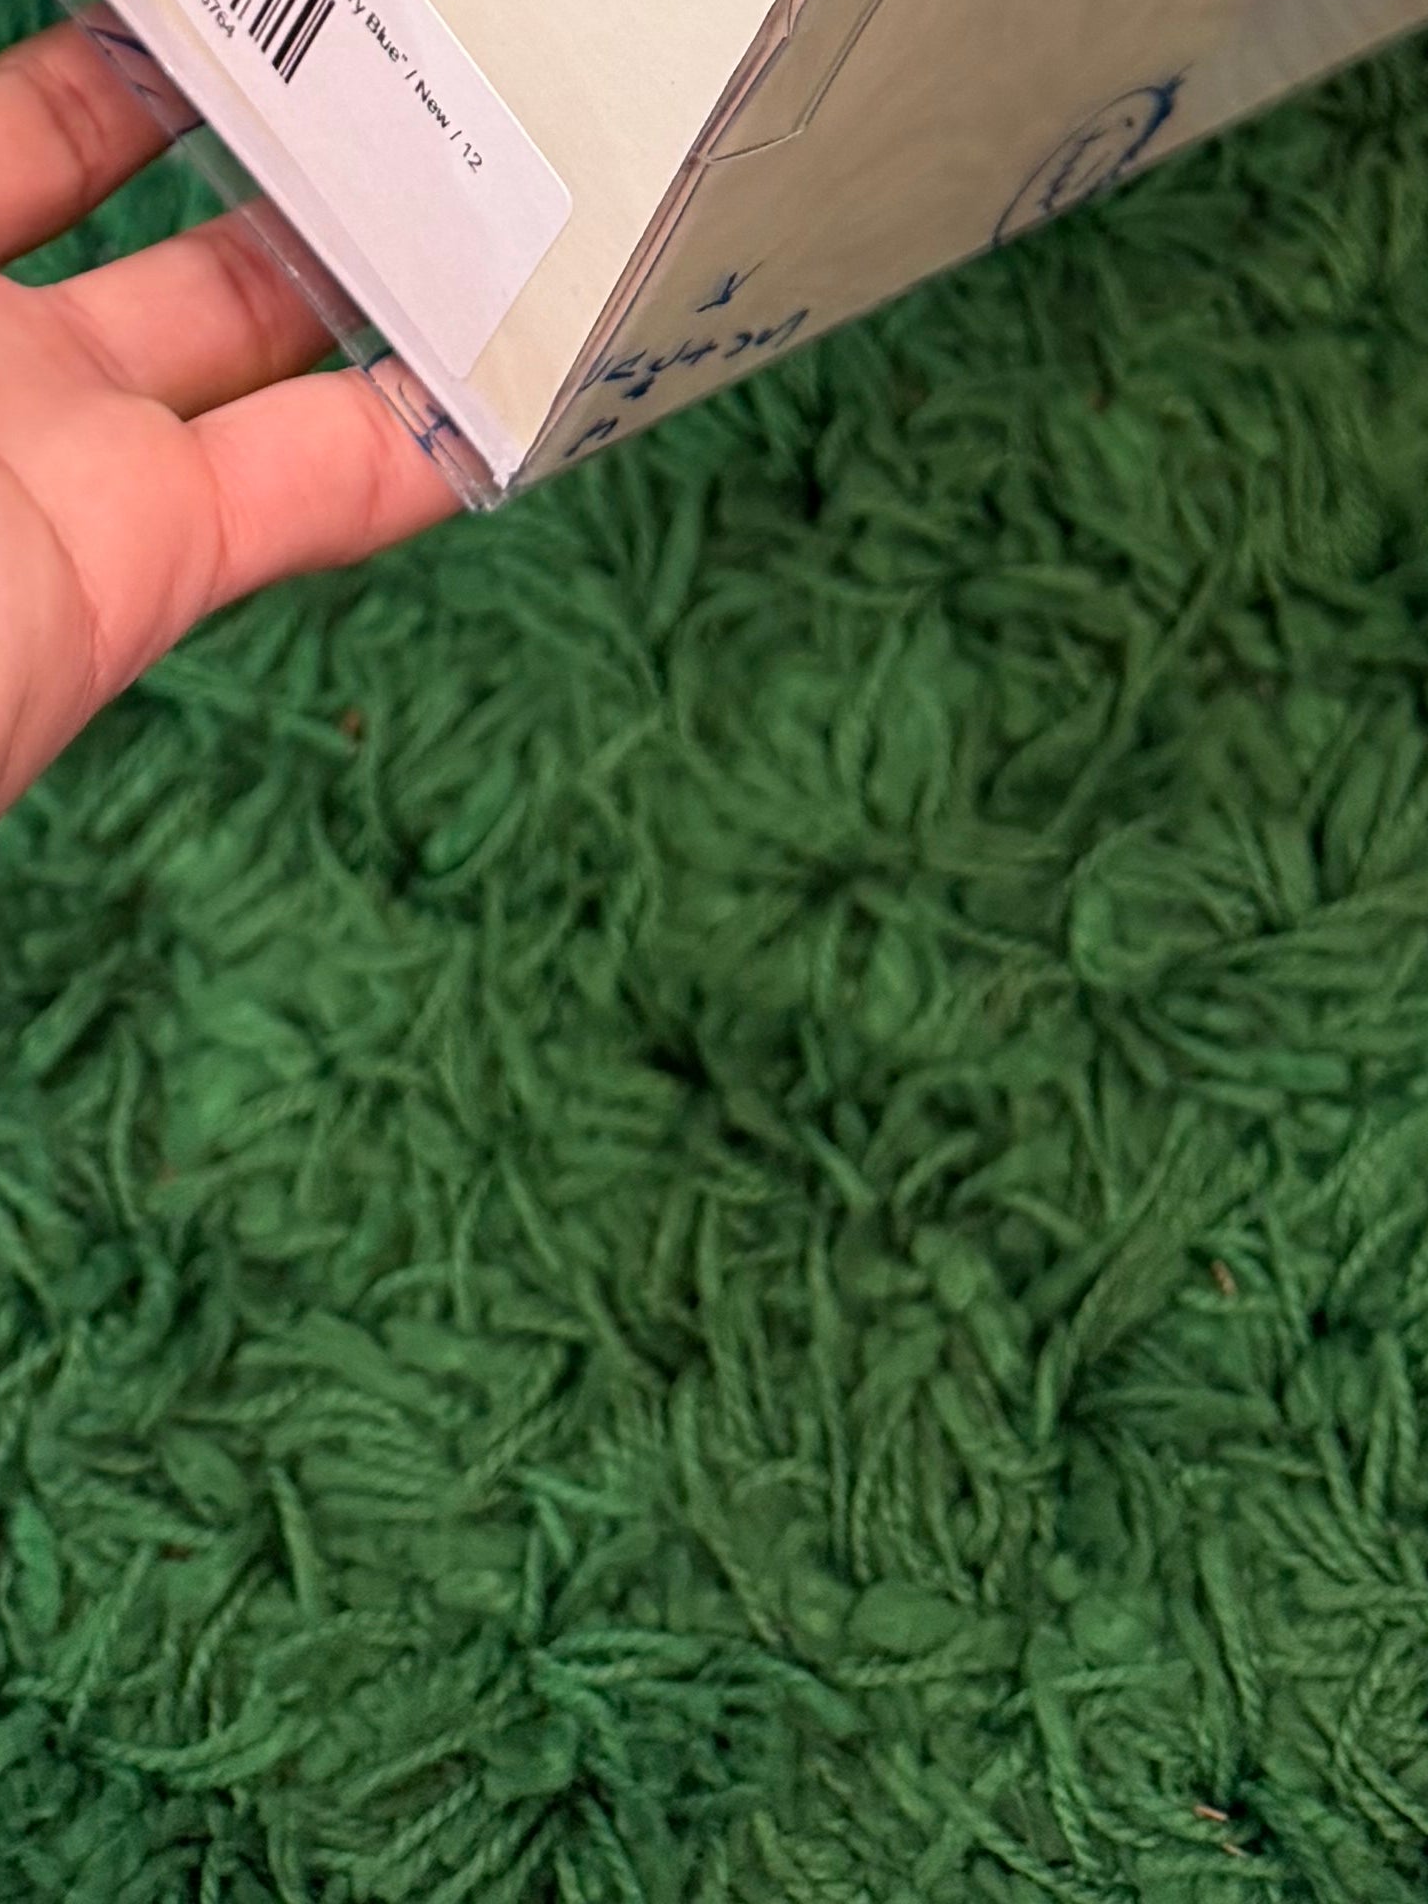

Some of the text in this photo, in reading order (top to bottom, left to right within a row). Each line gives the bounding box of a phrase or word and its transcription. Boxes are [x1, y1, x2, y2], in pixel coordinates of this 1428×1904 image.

[365, 12, 408, 63] Blue"
[404, 69, 418, 80] /
[414, 79, 451, 129] New
[449, 130, 463, 141] /
[461, 142, 483, 174] 12
